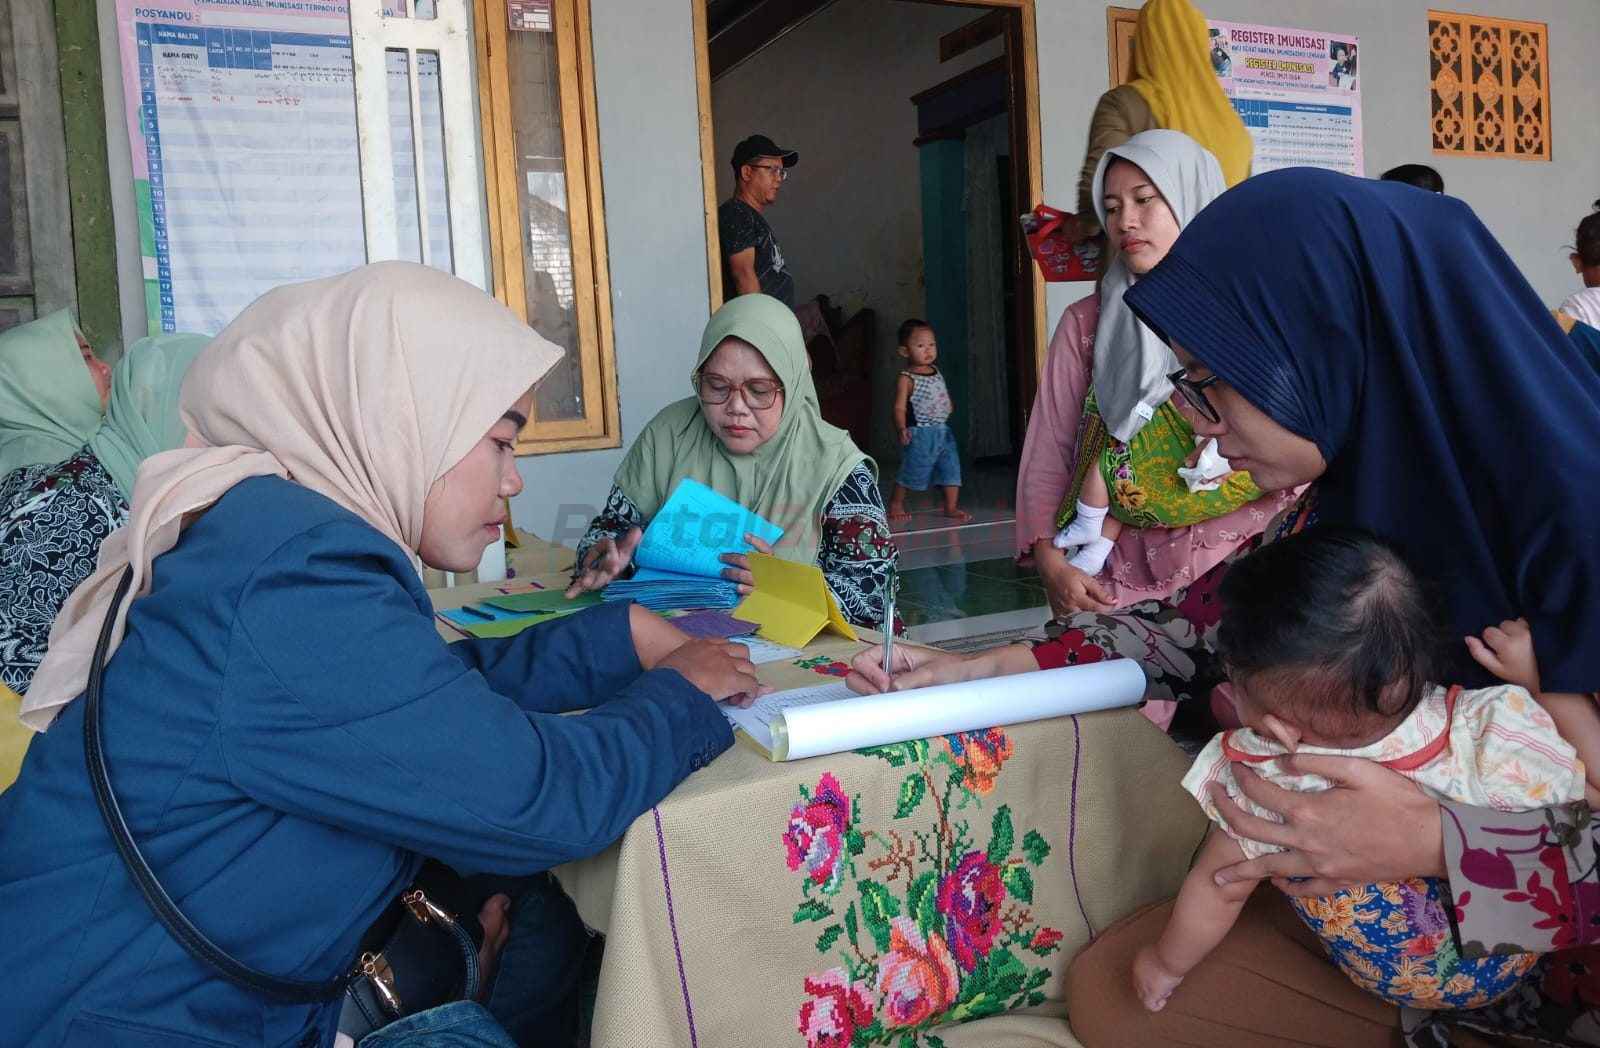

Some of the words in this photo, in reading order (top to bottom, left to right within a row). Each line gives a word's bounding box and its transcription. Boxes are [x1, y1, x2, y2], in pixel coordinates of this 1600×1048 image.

[135, 8, 192, 20] POSYANDU
[1231, 29, 1274, 45] REGISTER
[1277, 35, 1325, 50] IMUNISASI
[164, 322, 174, 330] 20
